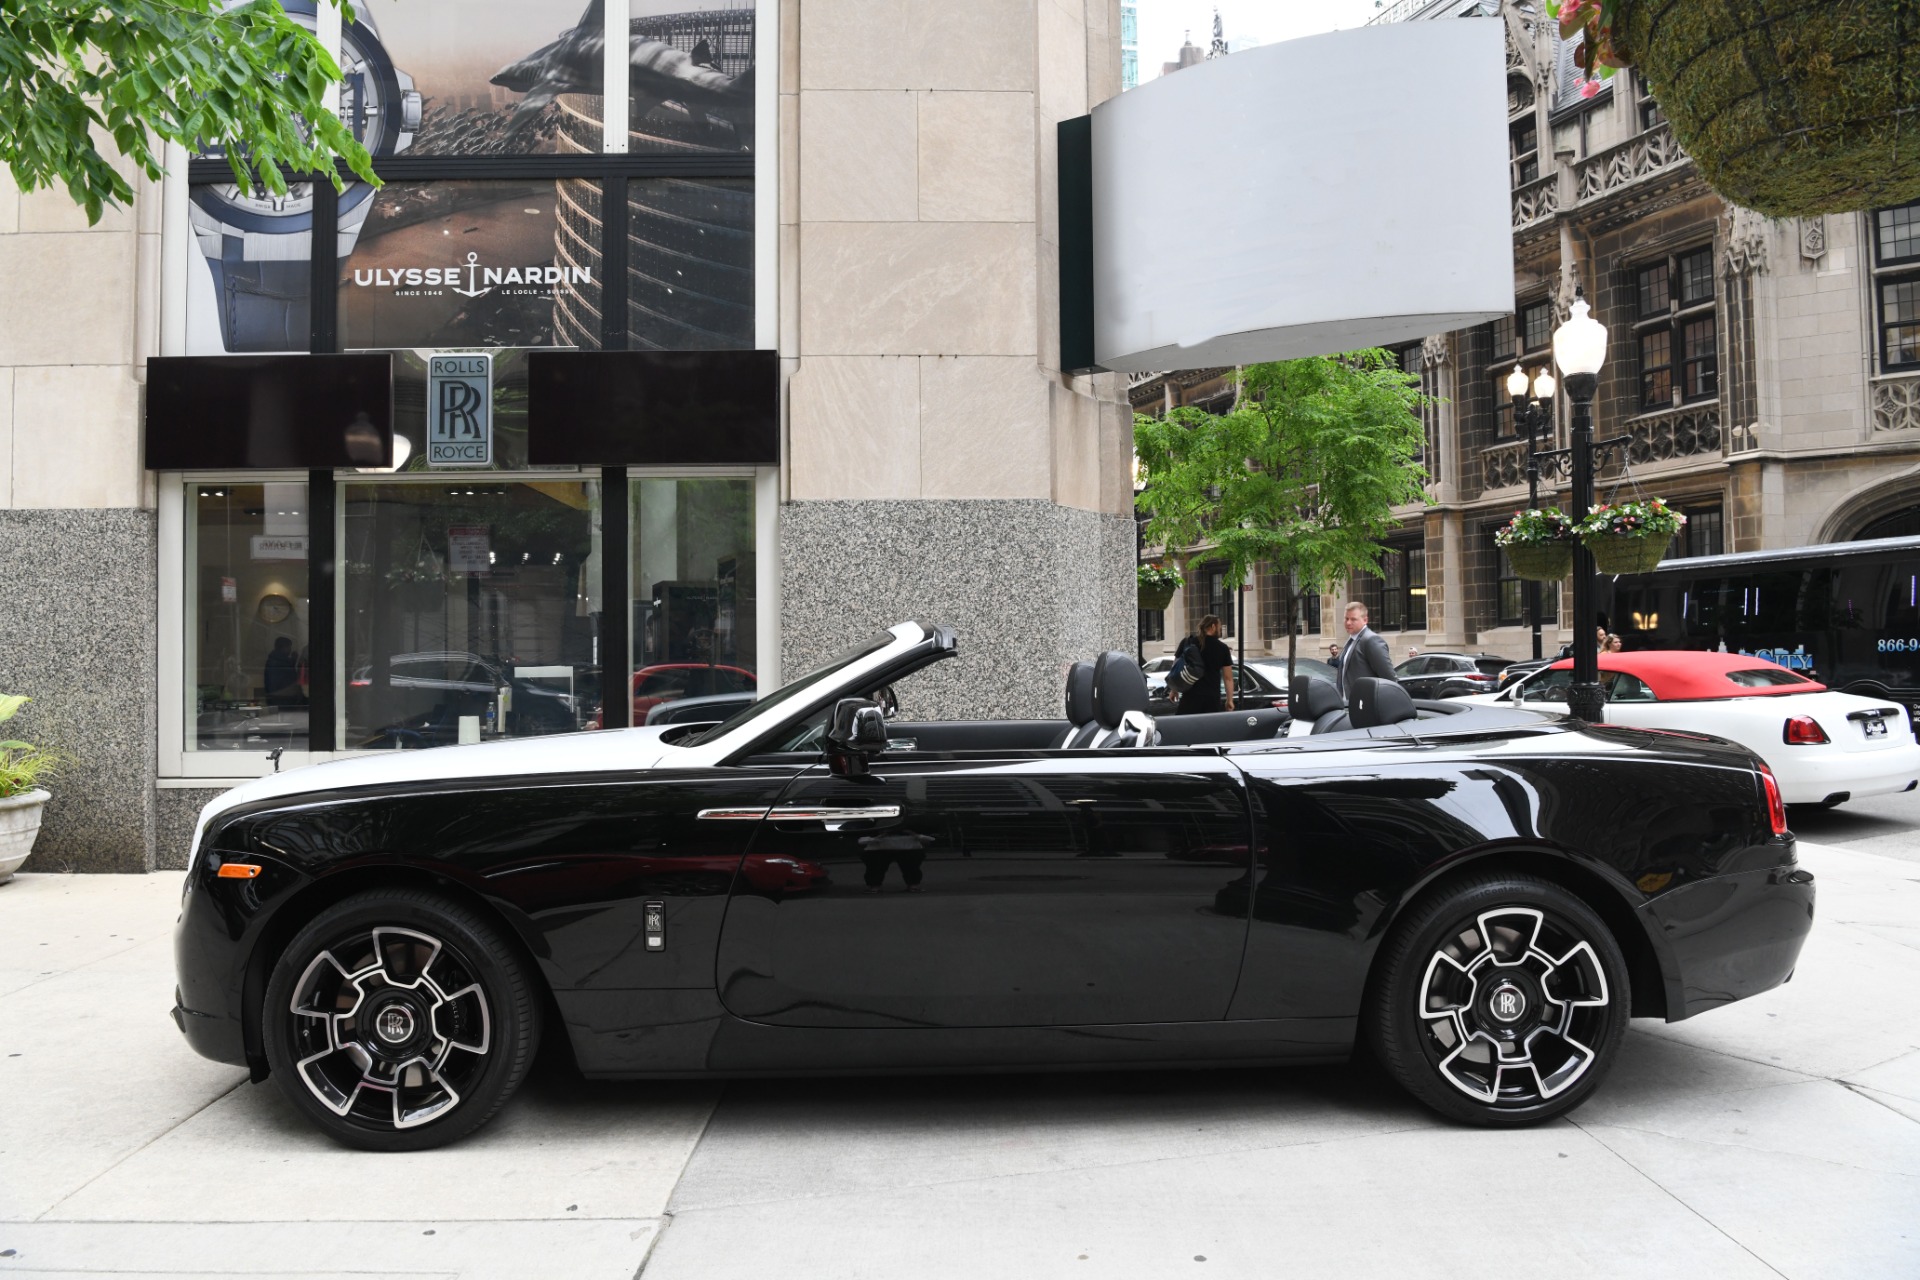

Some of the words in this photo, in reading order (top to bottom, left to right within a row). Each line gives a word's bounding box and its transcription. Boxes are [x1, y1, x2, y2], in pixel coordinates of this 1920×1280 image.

[354, 268, 461, 287] ULYSSE
[483, 266, 592, 285] NARDIN
[434, 360, 485, 373] ROLLS
[433, 445, 484, 459] ROYCE
[1877, 638, 1920, 652] 866-9
